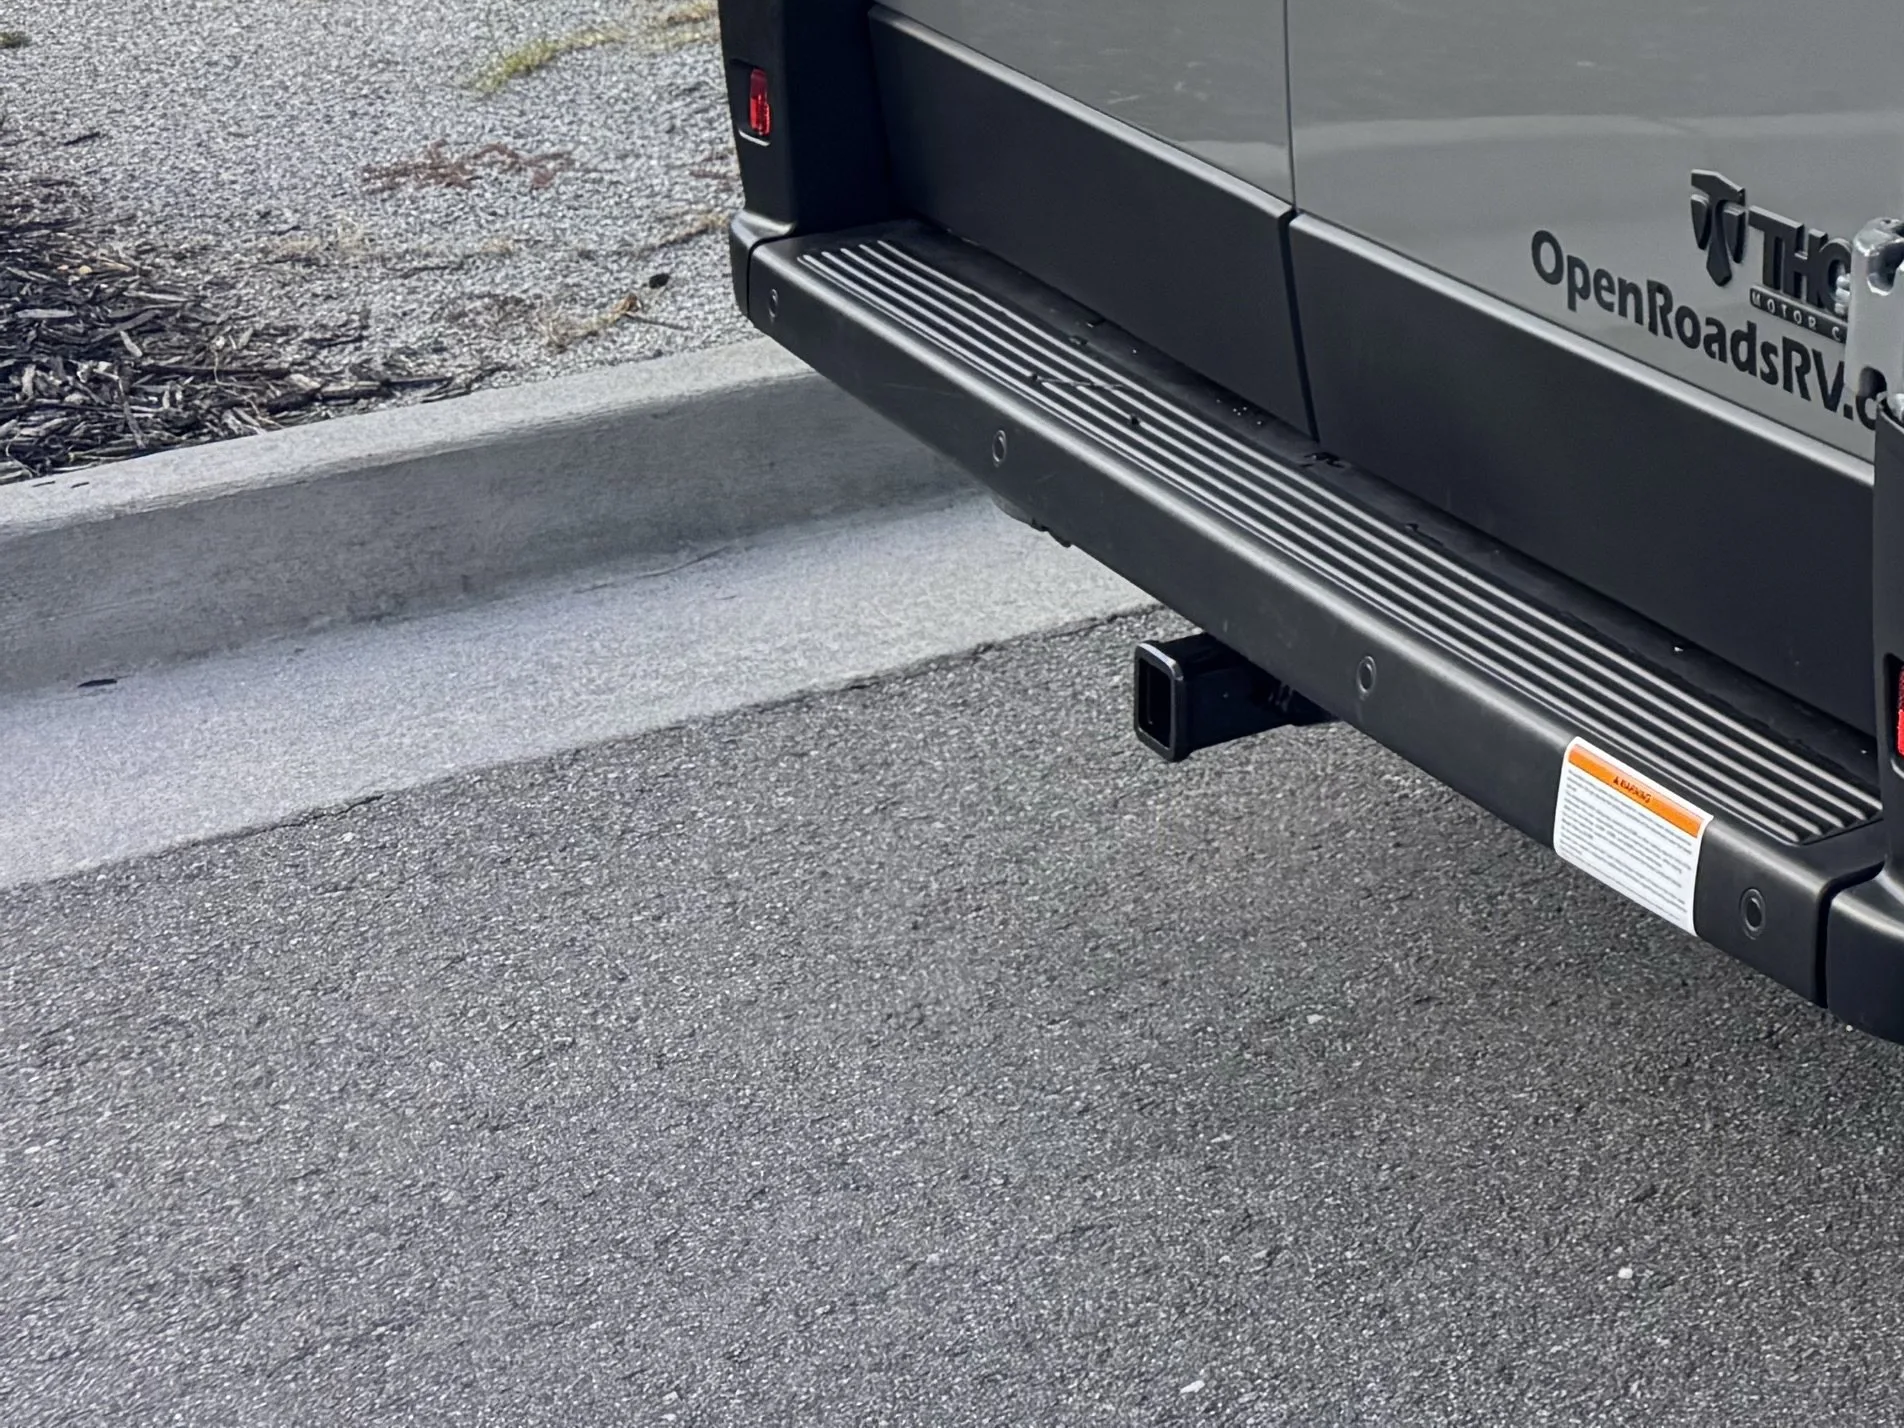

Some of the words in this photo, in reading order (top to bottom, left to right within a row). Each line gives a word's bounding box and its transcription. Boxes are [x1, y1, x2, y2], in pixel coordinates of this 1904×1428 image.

[1749, 206, 1851, 316] THO
[1751, 289, 1818, 331] MOTOR
[1531, 229, 1877, 431] OpenRoadsRV.c
